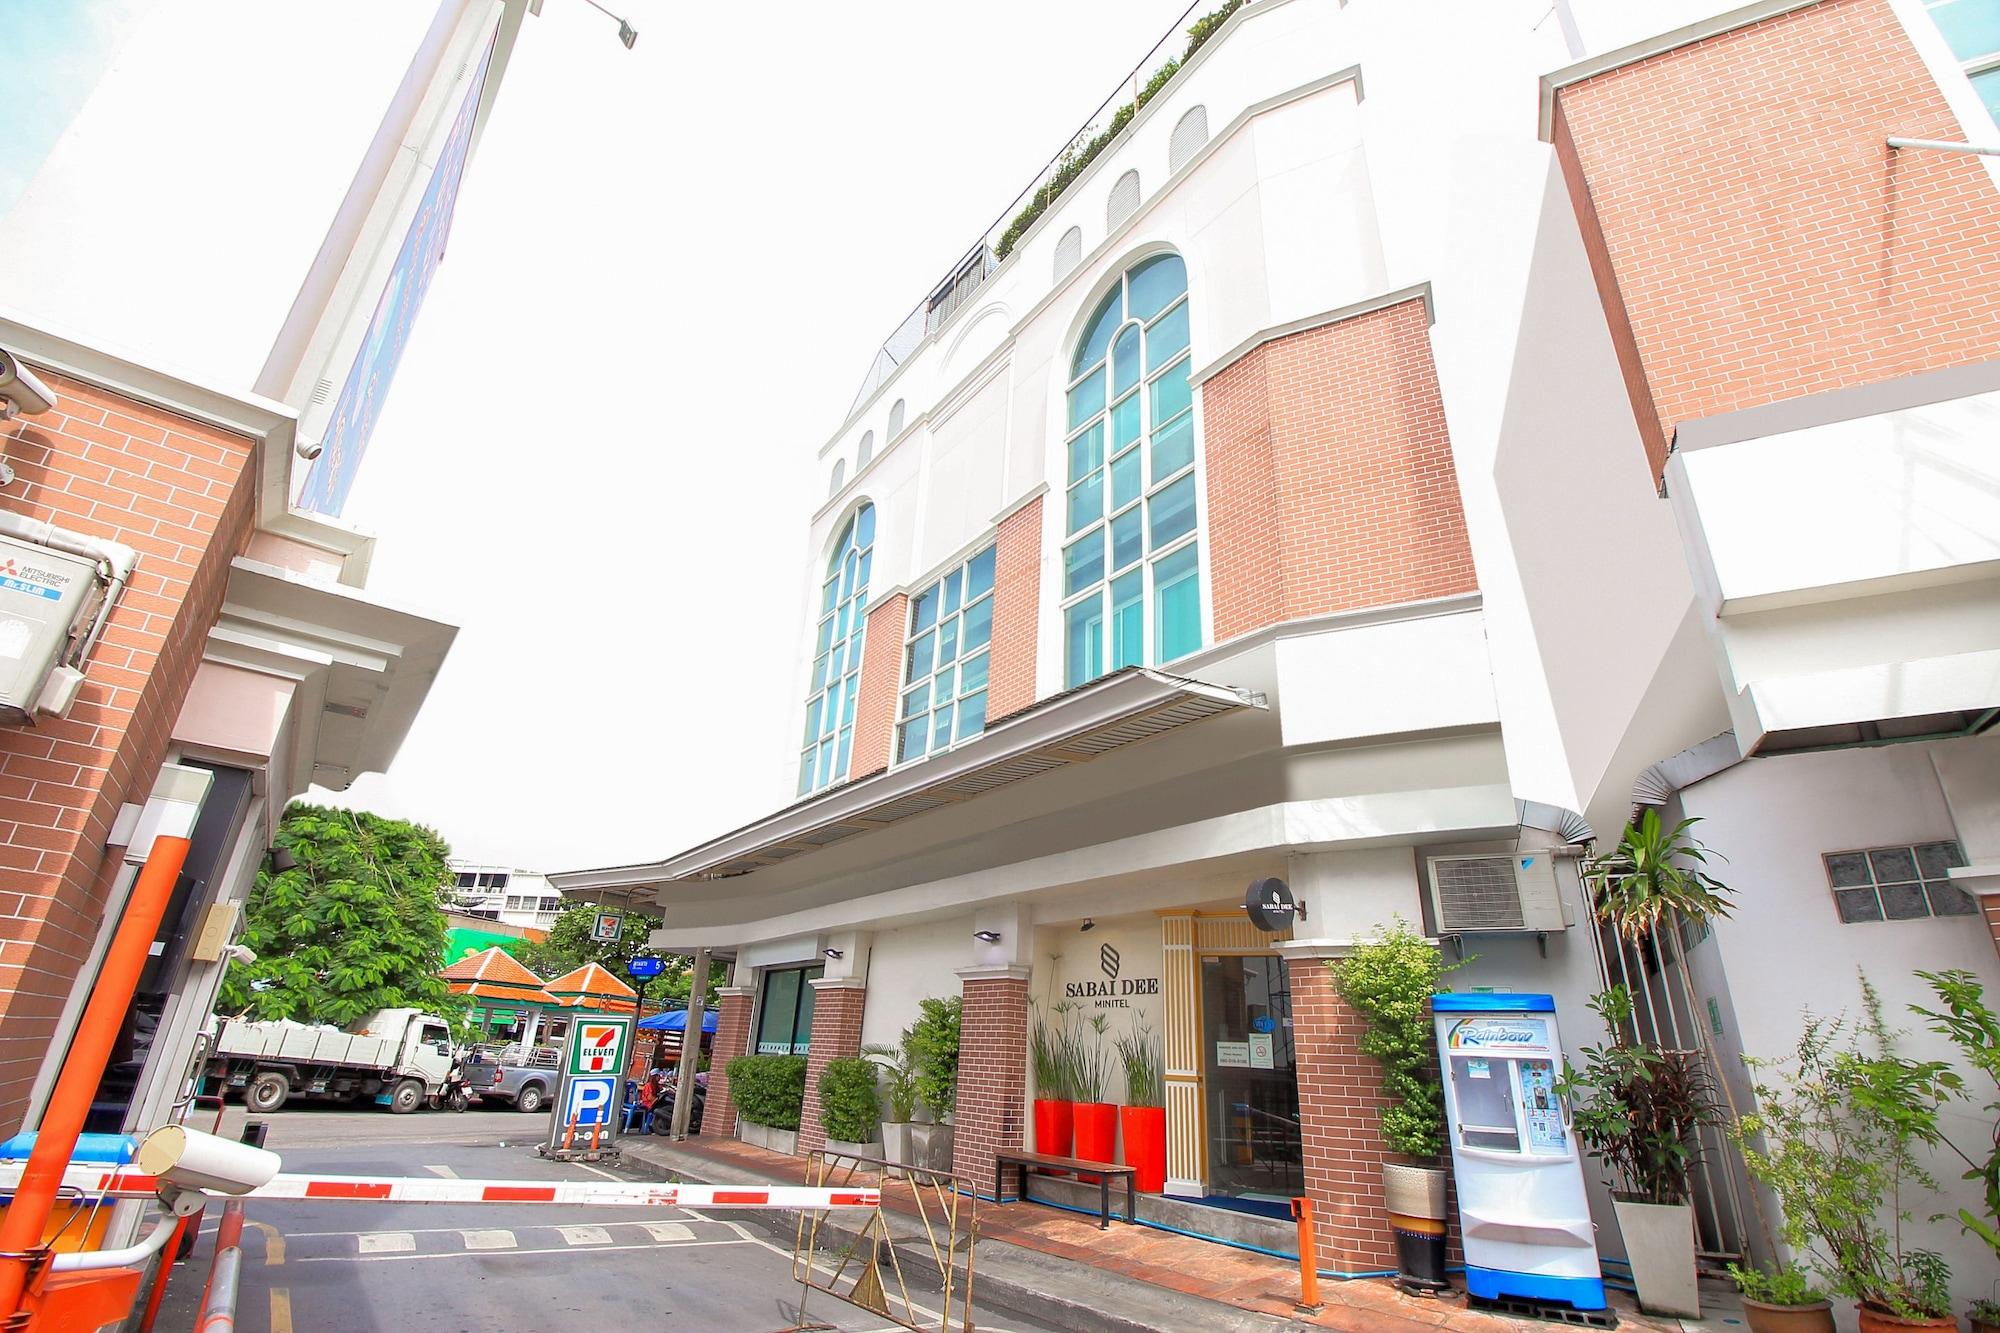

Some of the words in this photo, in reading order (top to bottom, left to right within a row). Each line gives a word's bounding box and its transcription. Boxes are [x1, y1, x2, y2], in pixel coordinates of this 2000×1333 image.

[19, 571, 61, 587] ELECTRIC
[21, 566, 71, 584] MITSUBISHI
[655, 961, 661, 970] 5
[1065, 980, 1116, 998] SABAI
[1121, 978, 1158, 995] DEE
[1094, 999, 1130, 1008] MINITEL
[1458, 1026, 1533, 1045] Rainbow
[582, 1048, 615, 1056] ELEVEN
[569, 1081, 611, 1121] P
